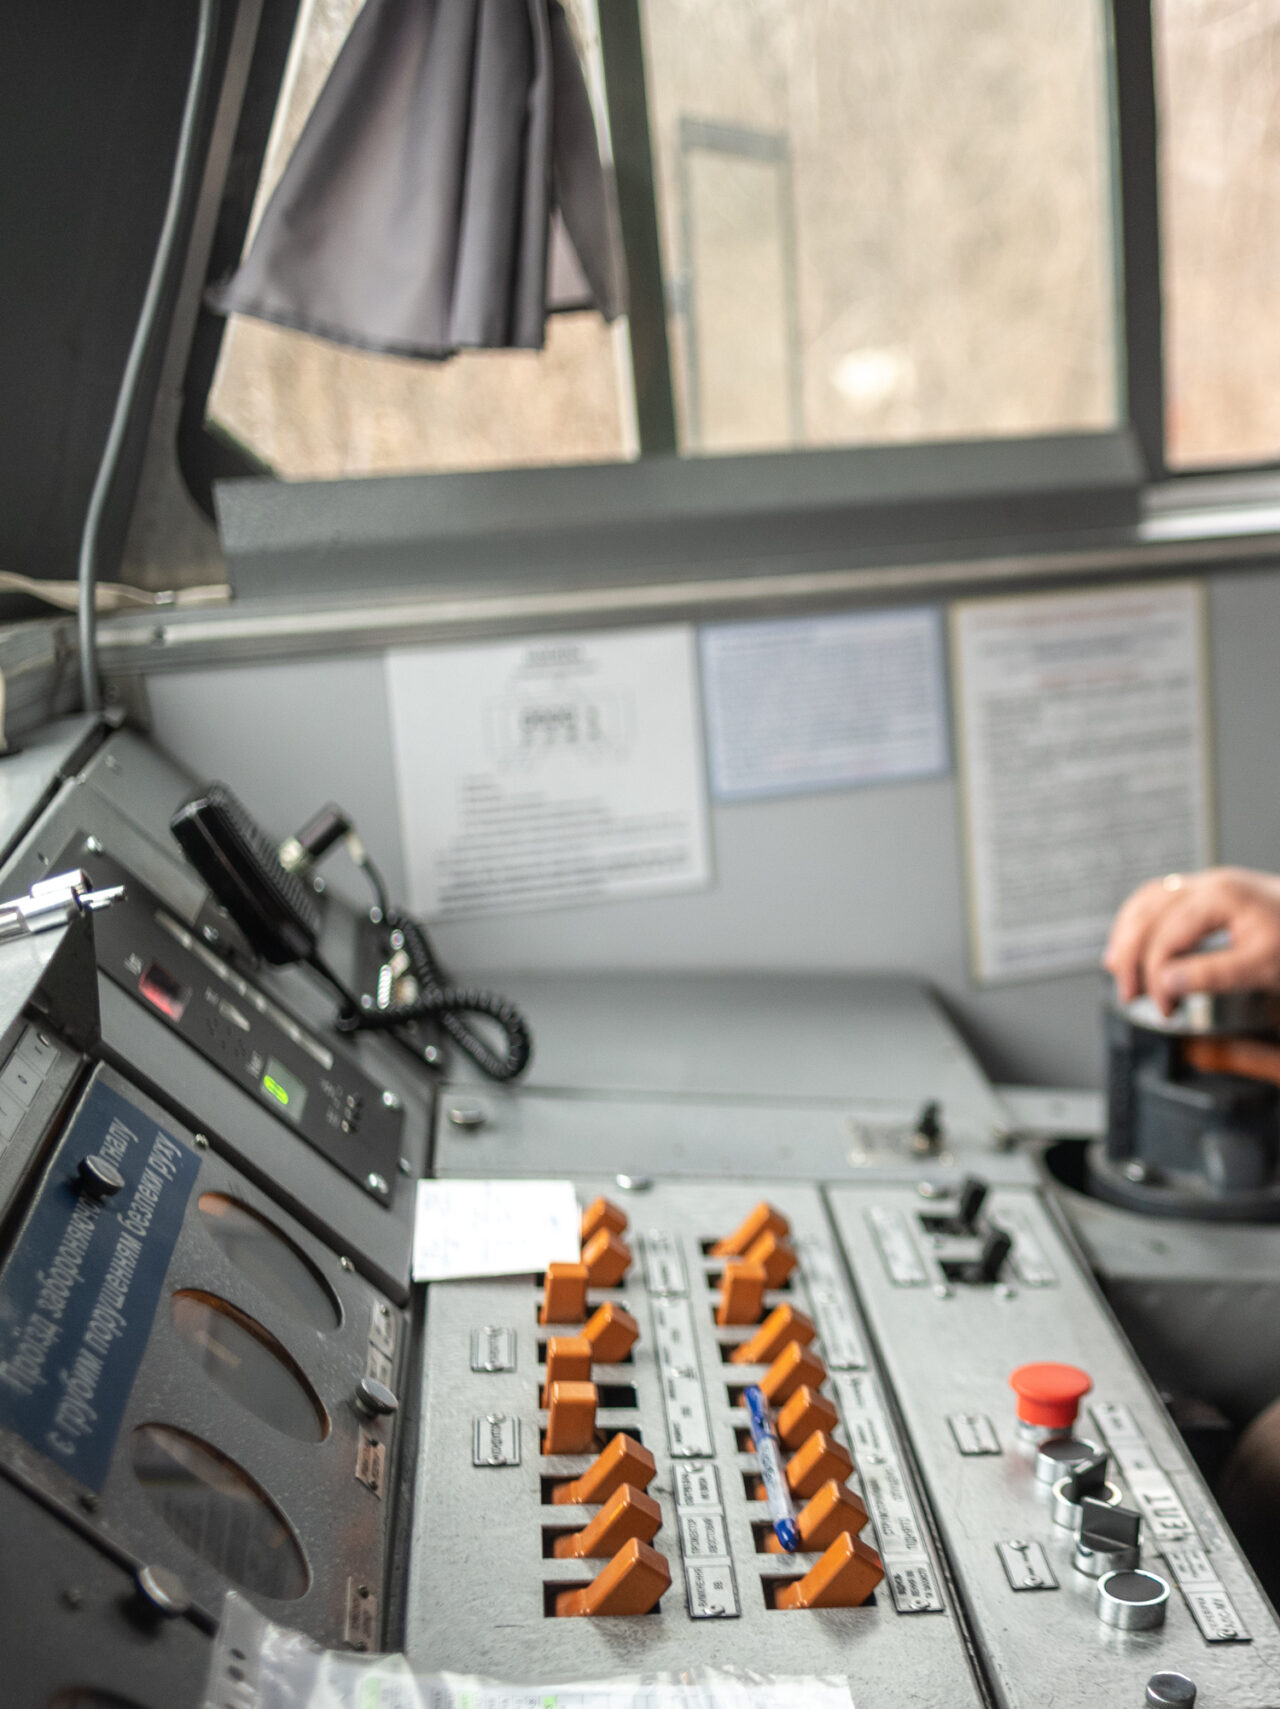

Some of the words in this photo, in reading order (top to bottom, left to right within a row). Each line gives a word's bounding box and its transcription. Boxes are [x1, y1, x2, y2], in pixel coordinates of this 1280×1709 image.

[146, 1130, 184, 1182] руху
[115, 1168, 164, 1239] безпеки
[82, 1235, 145, 1356] порушенням
[0, 1312, 65, 1396] Проїзд
[54, 1347, 104, 1435] грубим
[46, 1430, 76, 1455] є
